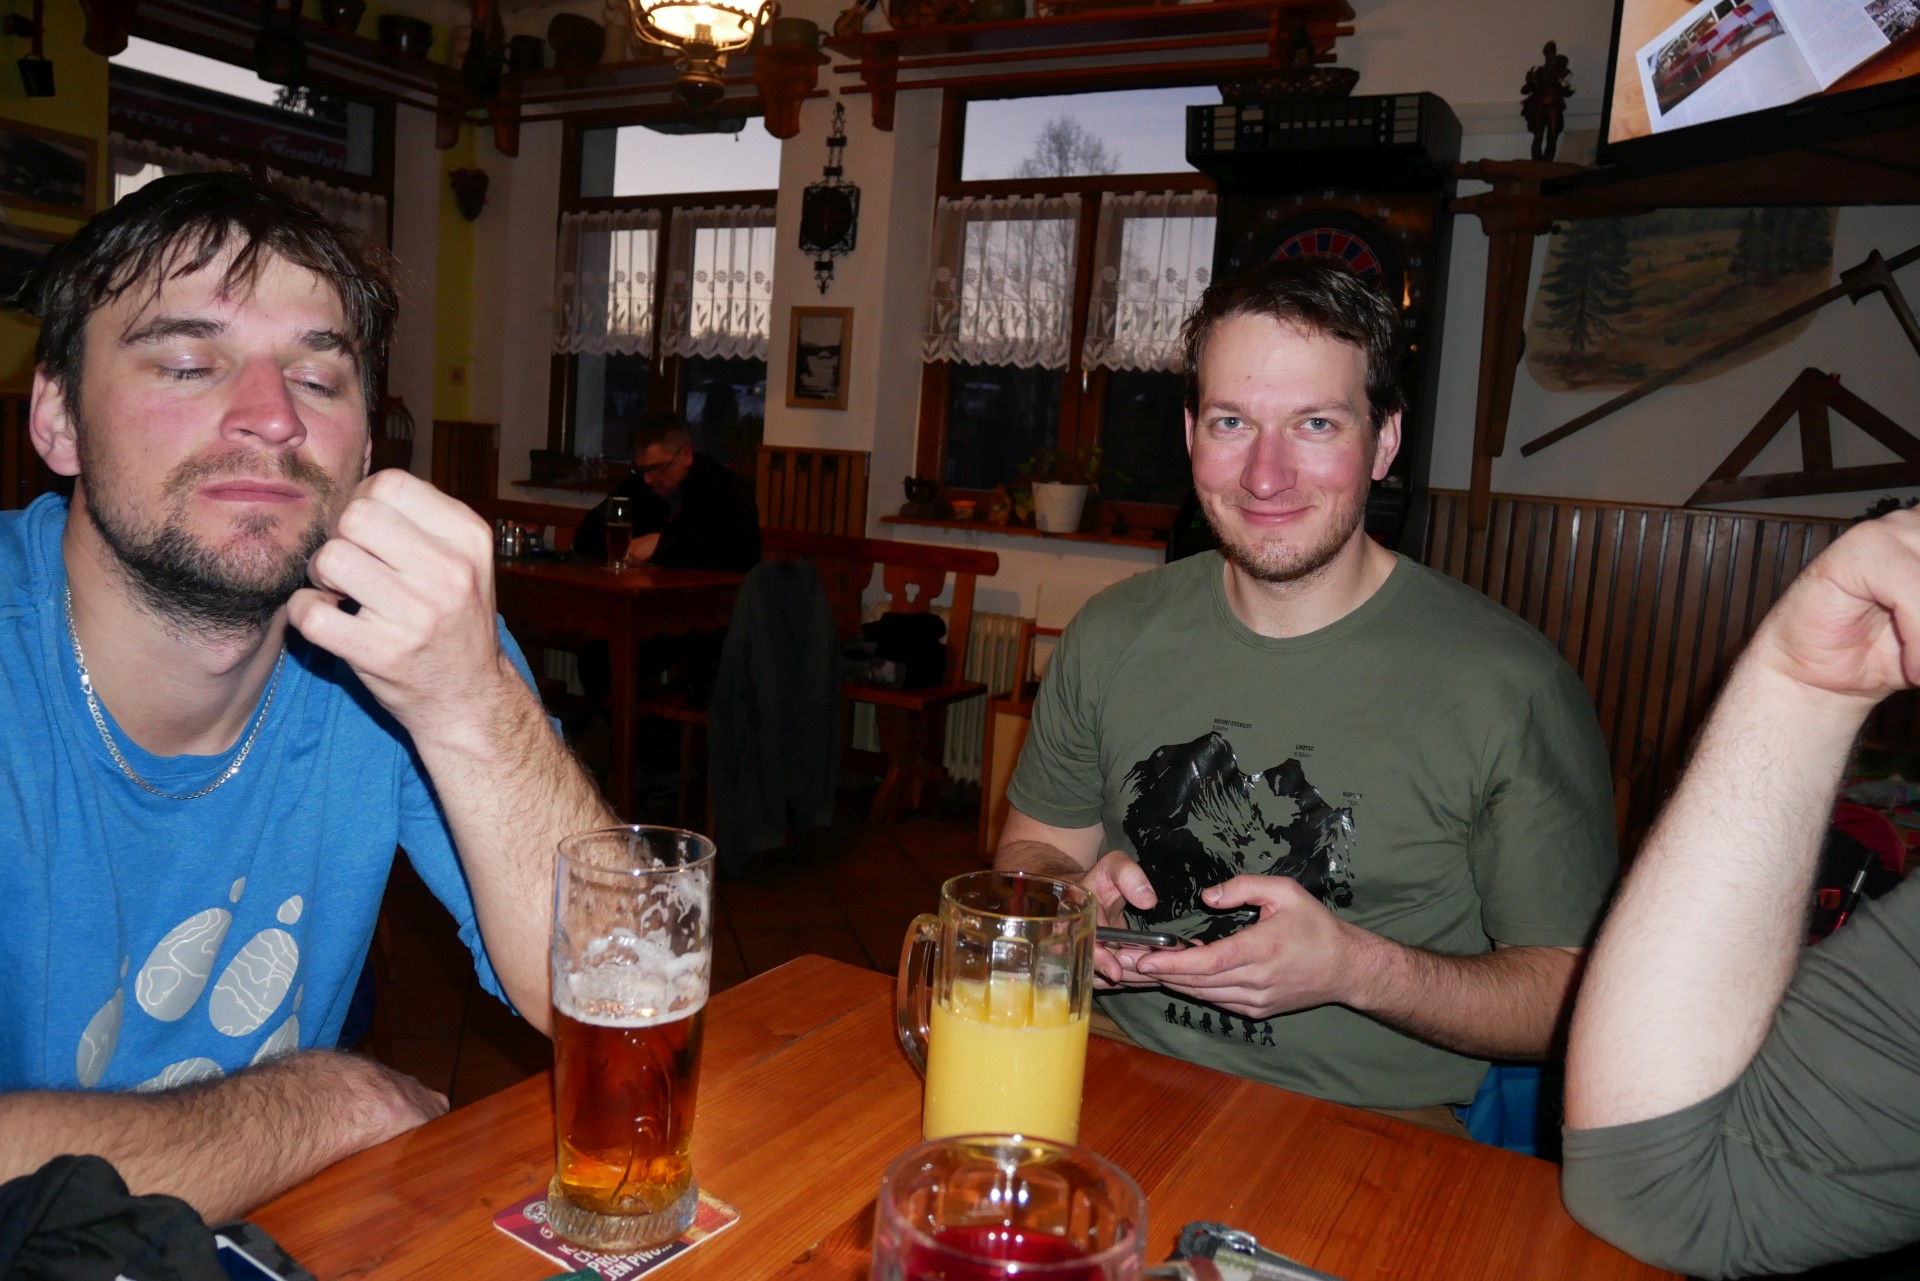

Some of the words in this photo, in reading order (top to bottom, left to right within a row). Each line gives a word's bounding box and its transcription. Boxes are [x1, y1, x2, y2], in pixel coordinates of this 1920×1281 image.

[1231, 720, 1252, 730] EVEREST
[1295, 744, 1315, 752] LHOTSE
[603, 1260, 633, 1281] JEN
